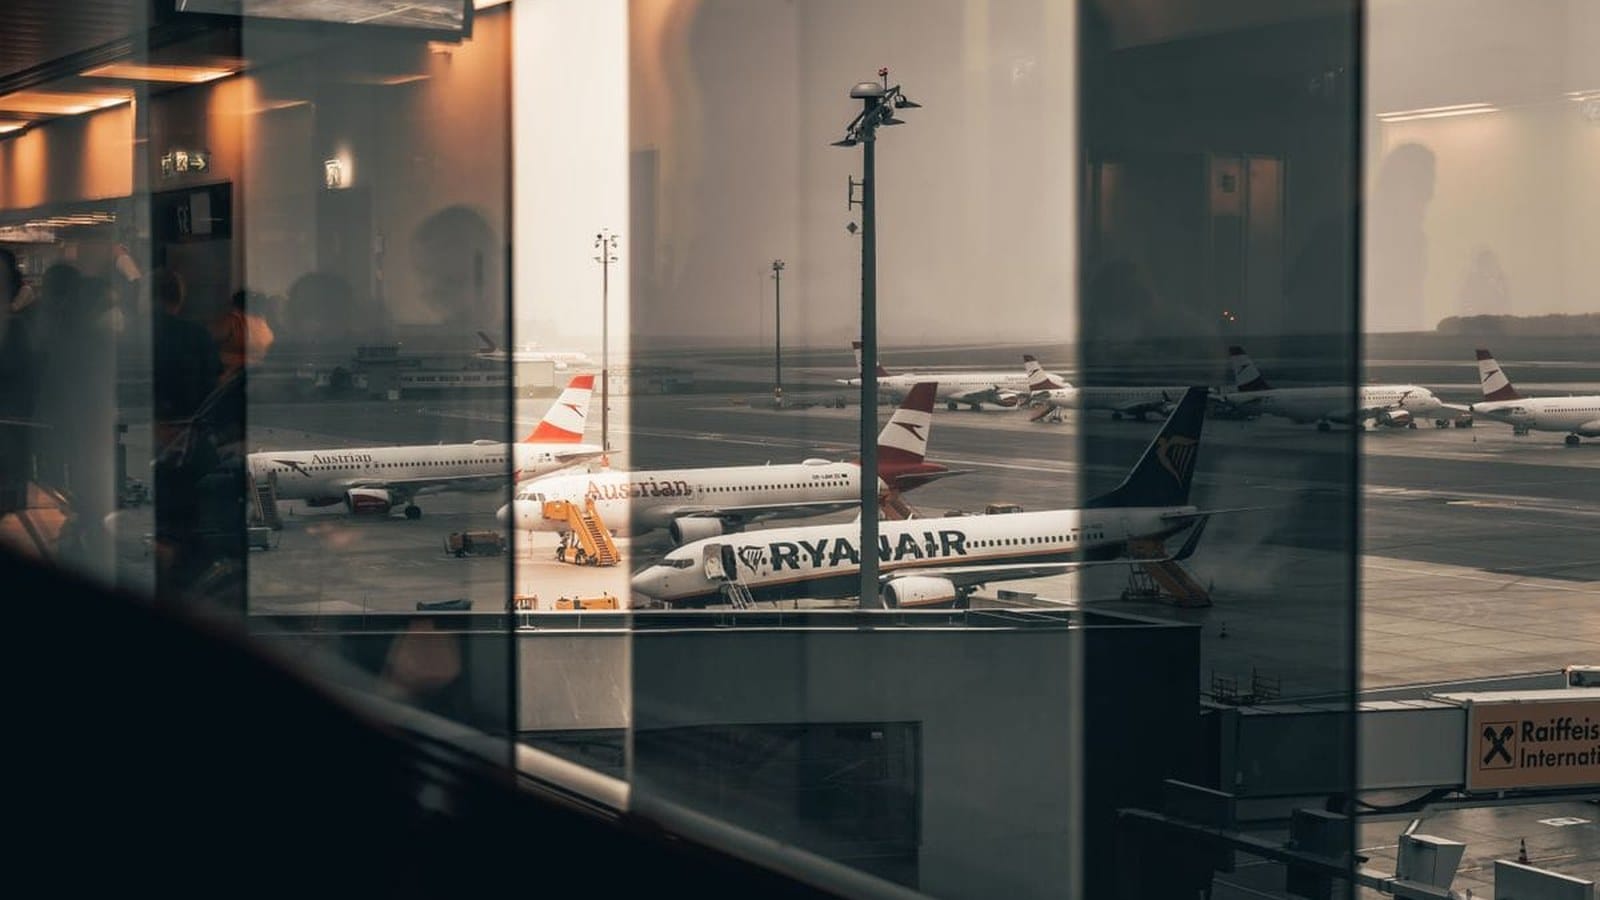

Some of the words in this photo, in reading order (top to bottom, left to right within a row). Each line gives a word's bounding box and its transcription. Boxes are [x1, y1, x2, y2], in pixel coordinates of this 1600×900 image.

[312, 454, 373, 464] Austrian
[585, 477, 689, 501] Austrian
[1521, 717, 1599, 742] Raiffeis
